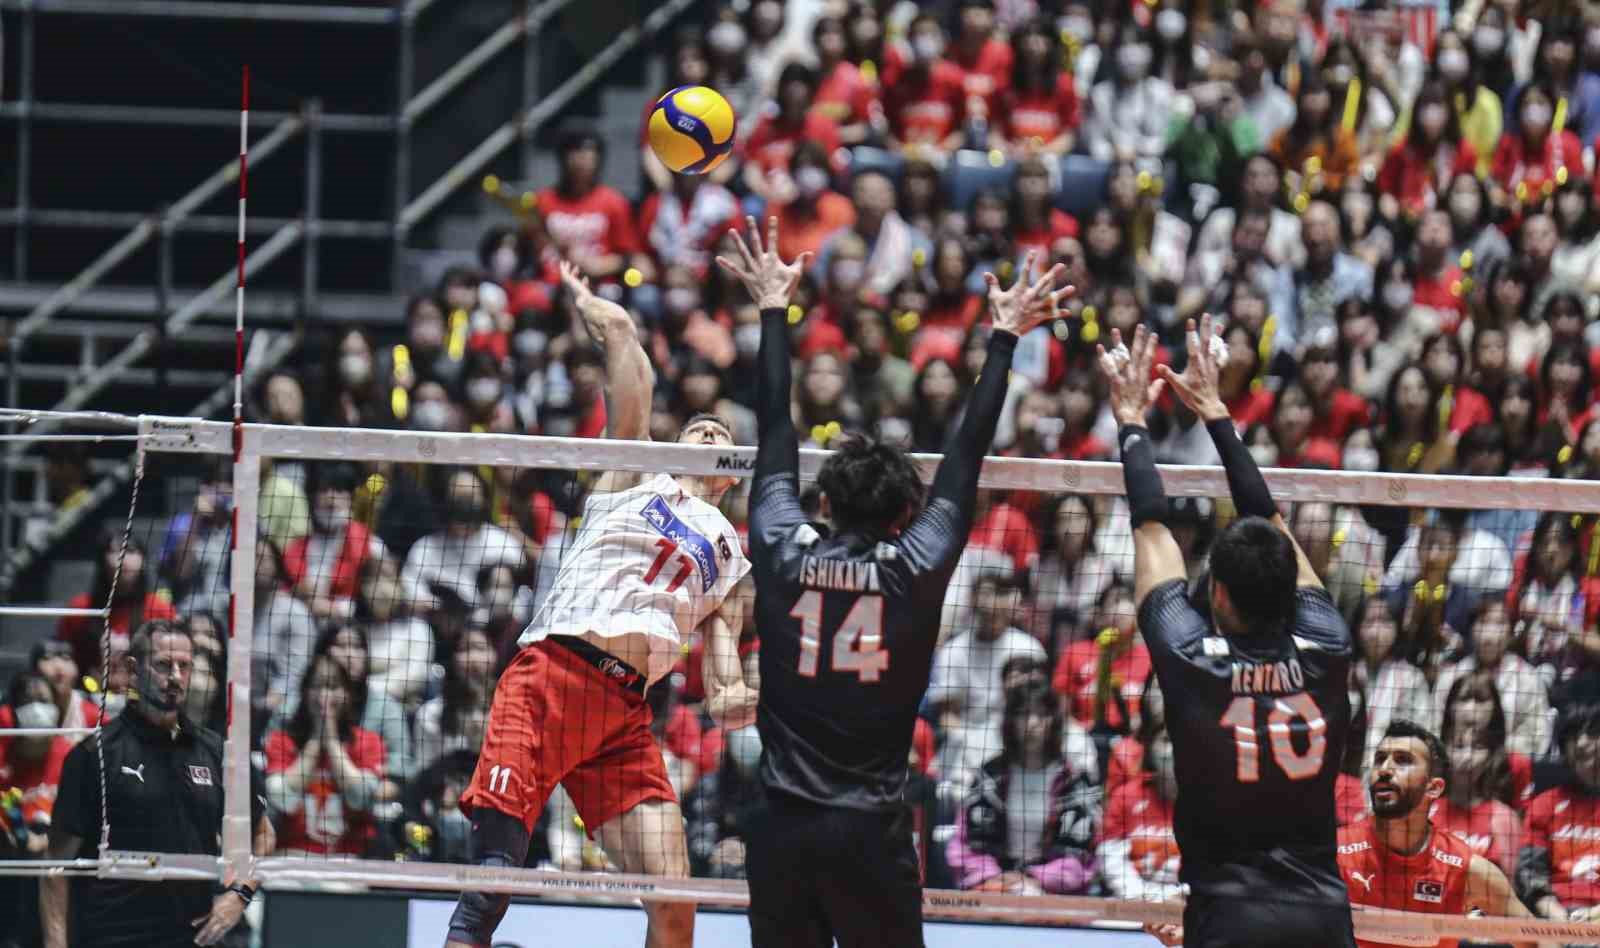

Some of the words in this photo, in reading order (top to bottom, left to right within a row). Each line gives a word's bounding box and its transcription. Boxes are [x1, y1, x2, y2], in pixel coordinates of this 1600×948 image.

[643, 538, 695, 593] 11
[800, 554, 881, 592] ISHIKAWA
[788, 589, 890, 683] 14
[1231, 658, 1304, 694] KENTARO
[1218, 691, 1327, 782] 10
[489, 765, 512, 794] 11
